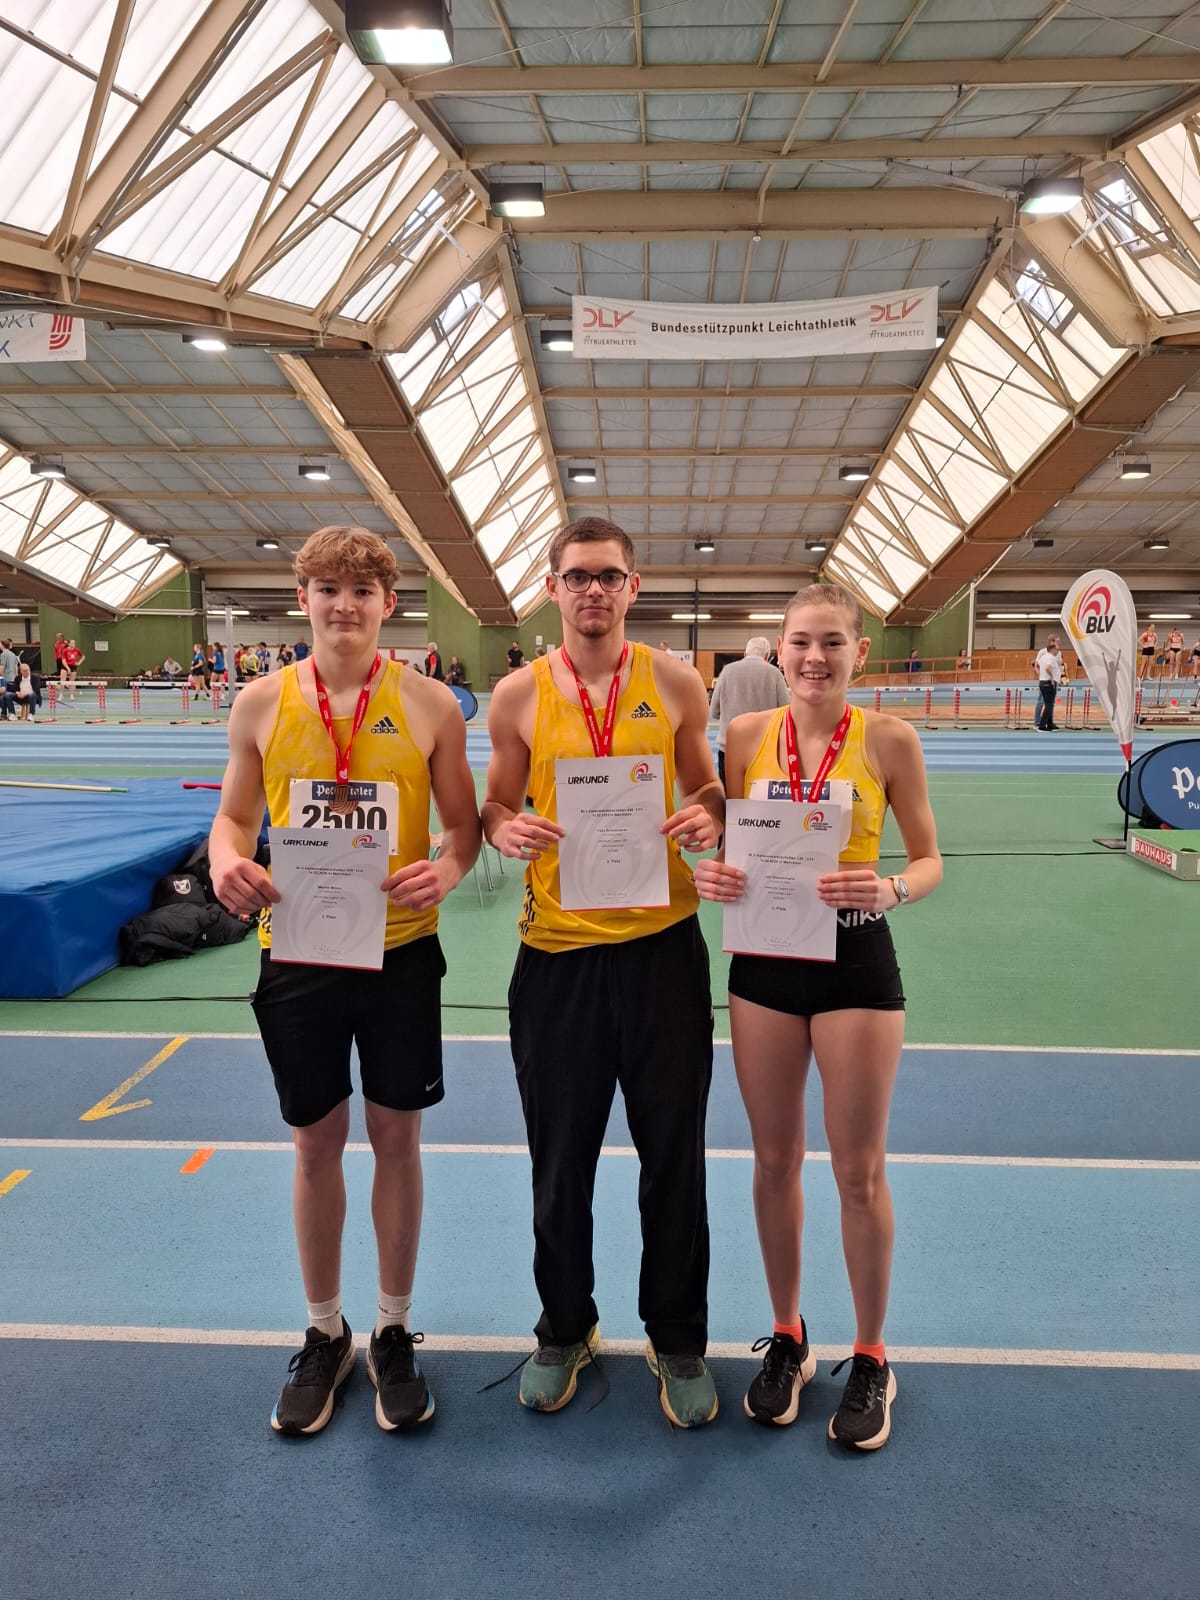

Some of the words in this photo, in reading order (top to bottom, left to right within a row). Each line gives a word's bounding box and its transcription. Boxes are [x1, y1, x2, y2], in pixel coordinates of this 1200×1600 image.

[583, 307, 635, 329] DLV
[870, 298, 924, 323] DLV
[651, 321, 764, 336] Bundesstützpunkt
[768, 317, 857, 333] Leichtathletik
[1086, 615, 1116, 634] BLV
[631, 711, 657, 720] adidas
[370, 726, 399, 735] adidas
[567, 775, 610, 785] URKUNDE
[301, 805, 388, 831] 2500
[738, 817, 782, 829] URKUNDE
[282, 839, 329, 847] URKUNDE
[1134, 839, 1172, 865] BAUHAUS
